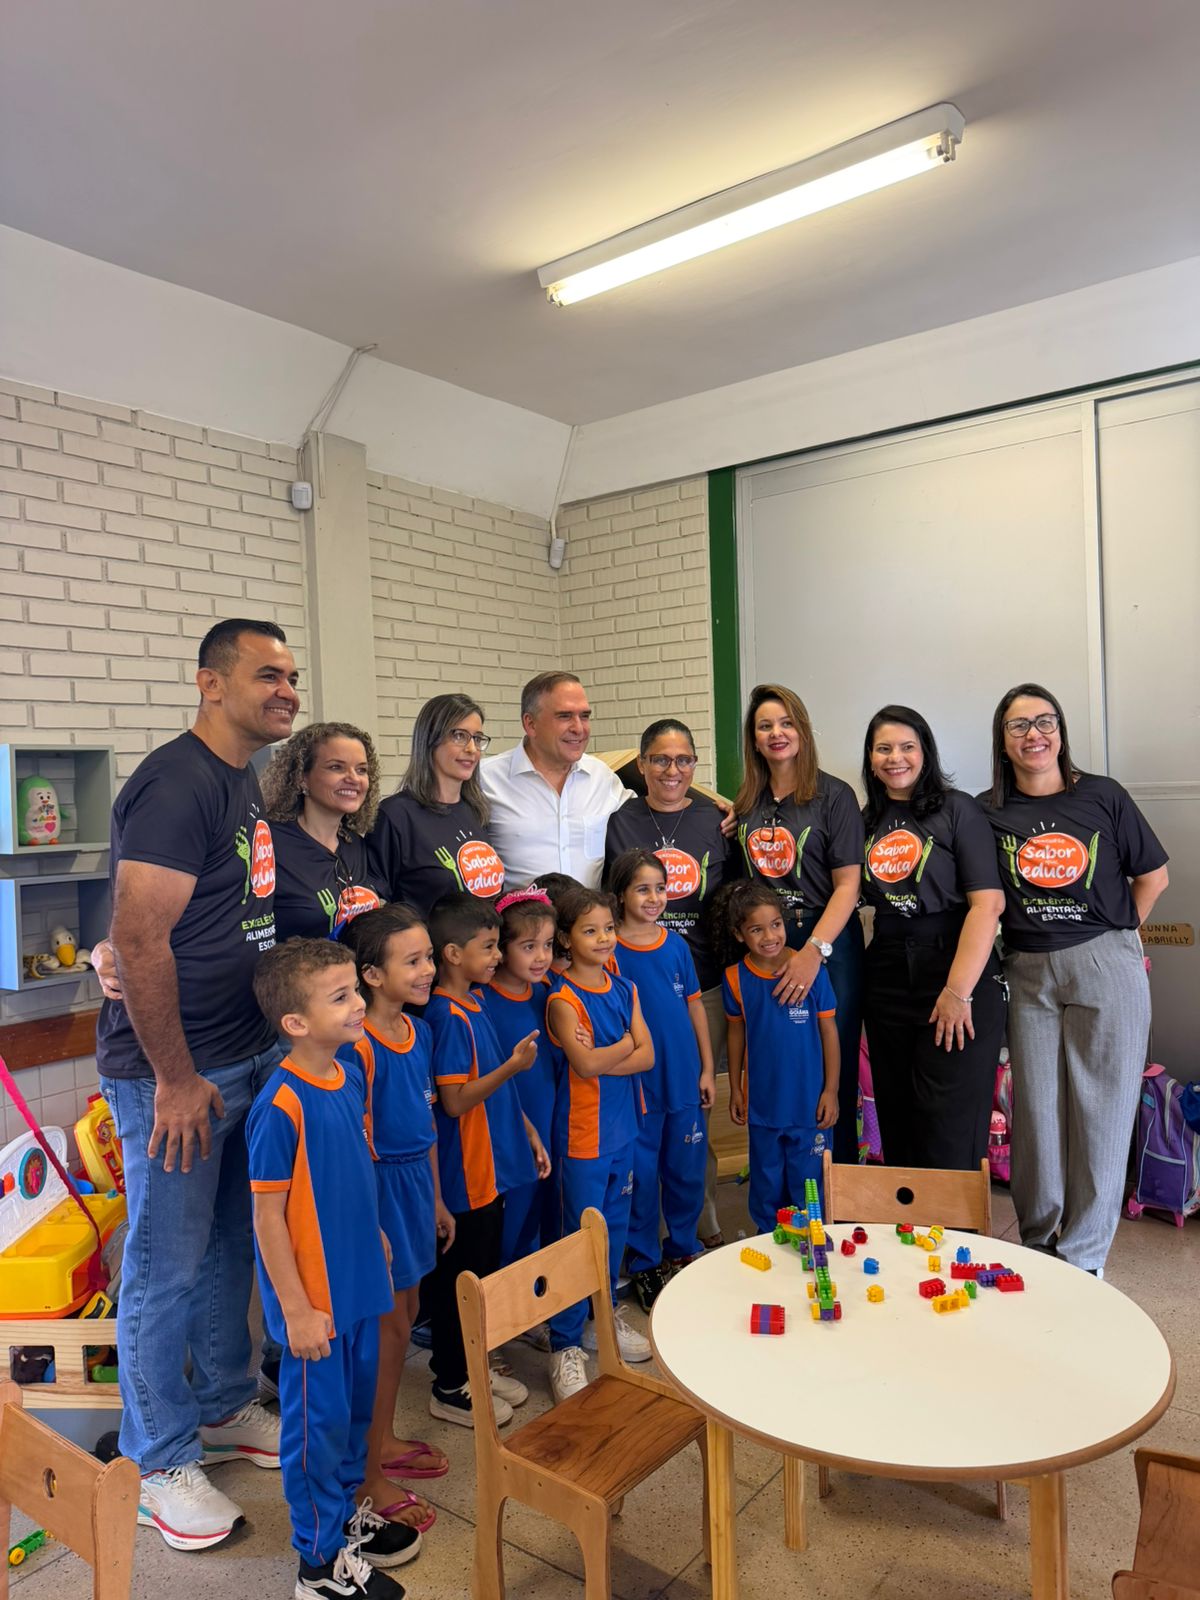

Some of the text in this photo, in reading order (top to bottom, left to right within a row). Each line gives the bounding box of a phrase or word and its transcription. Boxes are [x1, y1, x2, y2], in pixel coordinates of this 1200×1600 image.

[751, 836, 787, 851] Sabor
[875, 843, 914, 857] Sabor
[1024, 845, 1077, 859] Sabor
[462, 854, 498, 871] Sabor
[665, 860, 691, 875] bor
[871, 860, 911, 874] educa
[1021, 863, 1078, 879] educa
[466, 872, 504, 891] educa
[666, 880, 693, 893] uca
